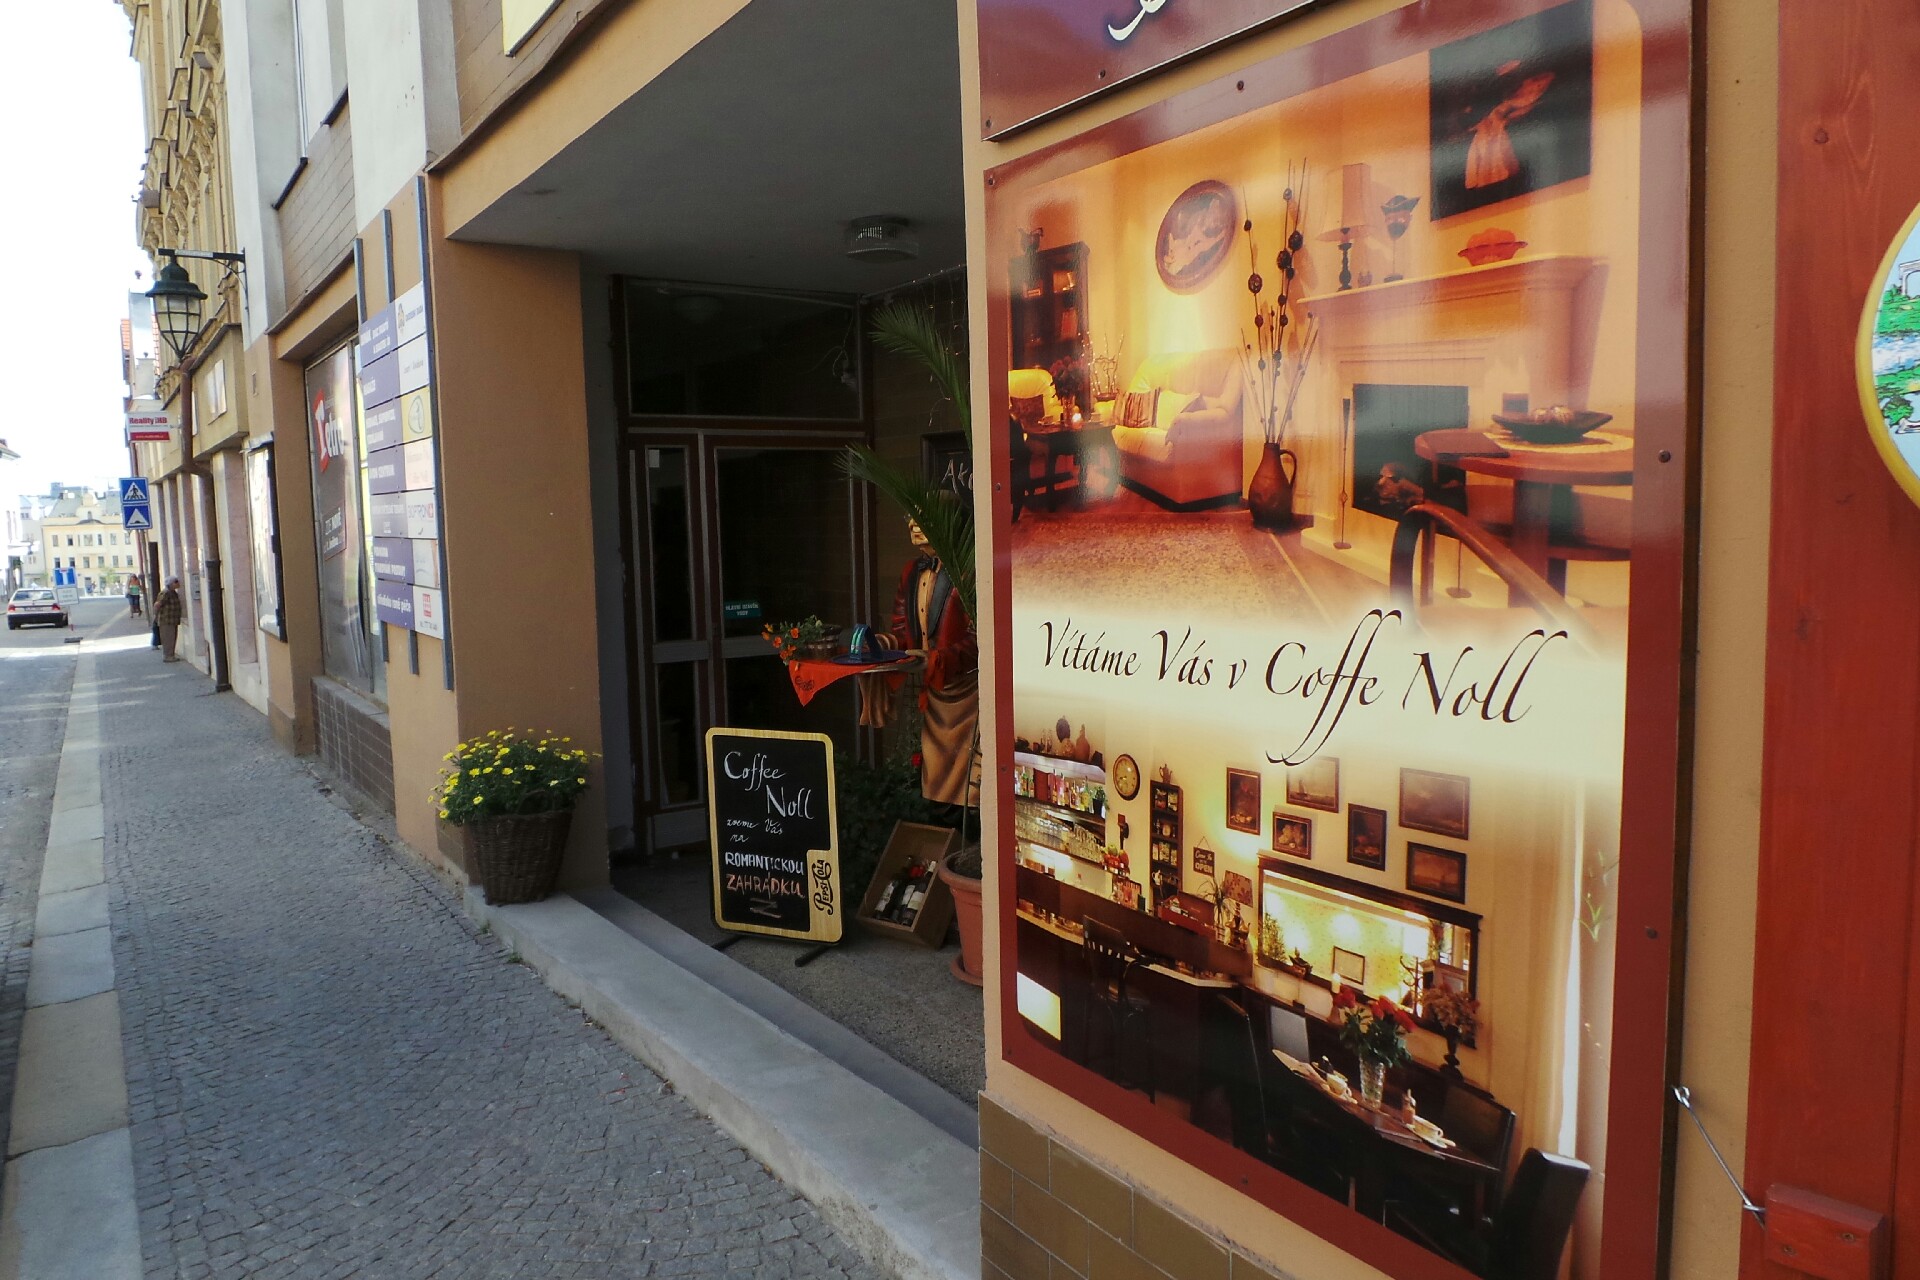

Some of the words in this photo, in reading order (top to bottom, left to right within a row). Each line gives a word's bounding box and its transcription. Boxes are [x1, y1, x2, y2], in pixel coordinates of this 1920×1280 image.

[129, 417, 154, 425] Reality
[1038, 617, 1142, 677] Vítáme
[1151, 625, 1213, 687] Vás
[1228, 659, 1248, 691] v
[1265, 608, 1402, 767] Coffe
[1402, 629, 1568, 724] Noll
[723, 751, 787, 792] Coffee
[766, 784, 815, 820] Noll
[725, 851, 805, 876] ROMANTICKOU
[726, 872, 806, 900] ZAHRÁDKU
